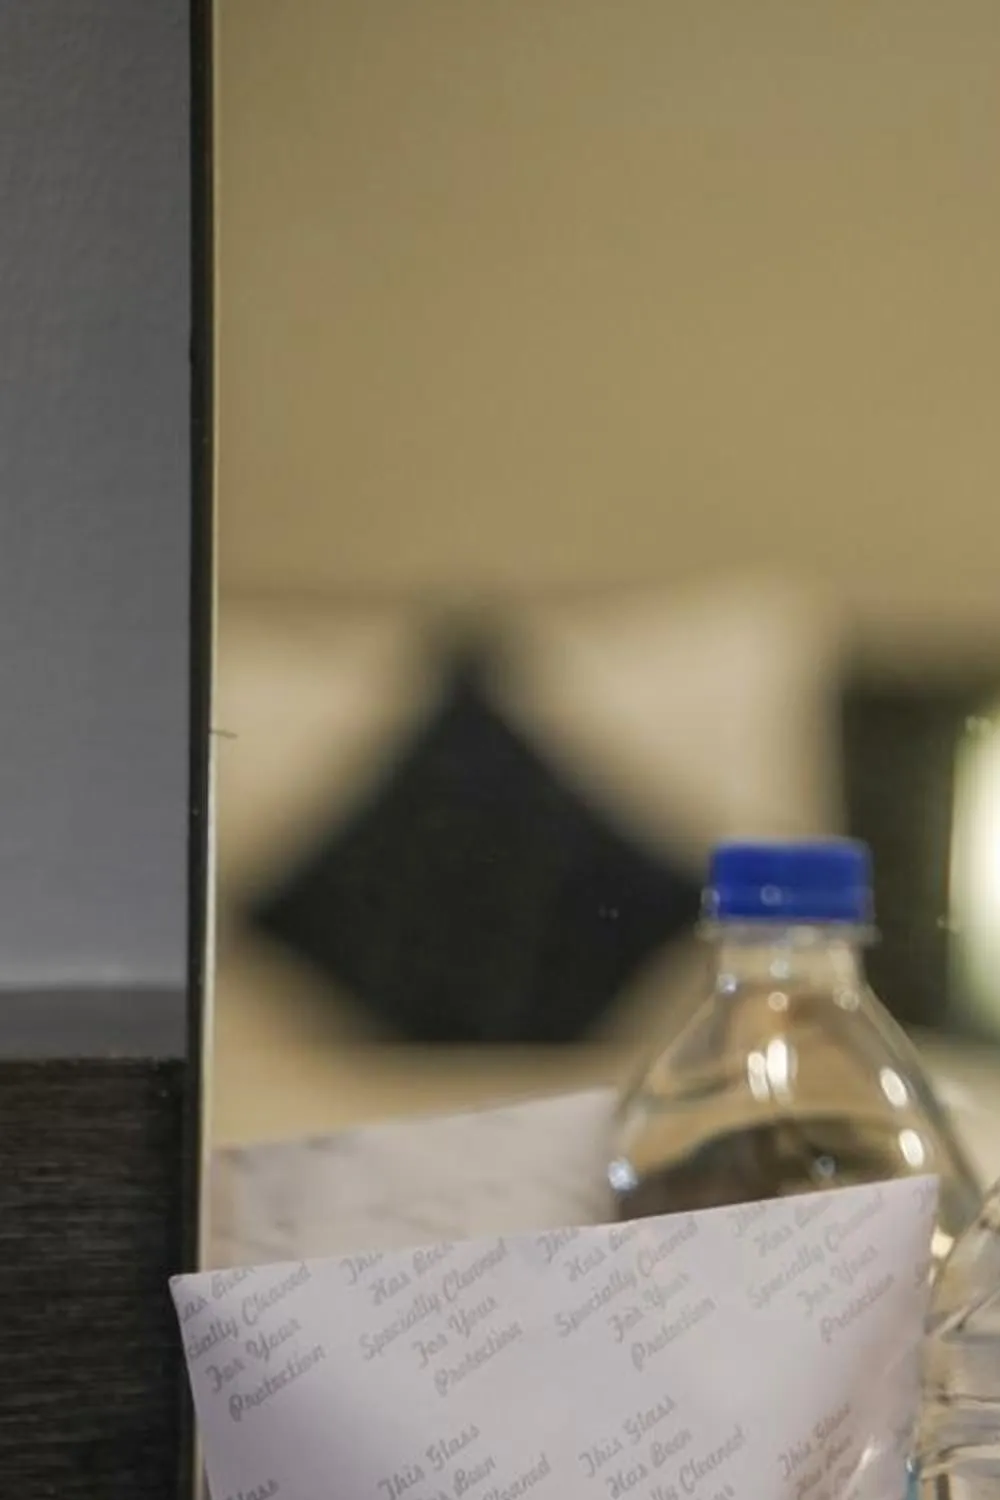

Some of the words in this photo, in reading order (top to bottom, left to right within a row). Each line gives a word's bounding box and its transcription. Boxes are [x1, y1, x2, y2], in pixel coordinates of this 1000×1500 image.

[425, 1423, 480, 1472] Glass
[578, 1436, 625, 1479] This
[621, 1392, 678, 1446] Glass
[604, 1463, 649, 1500] Has
[651, 1427, 694, 1469] Been
[679, 1421, 747, 1496] Cleaned
[453, 1454, 498, 1498] Been
